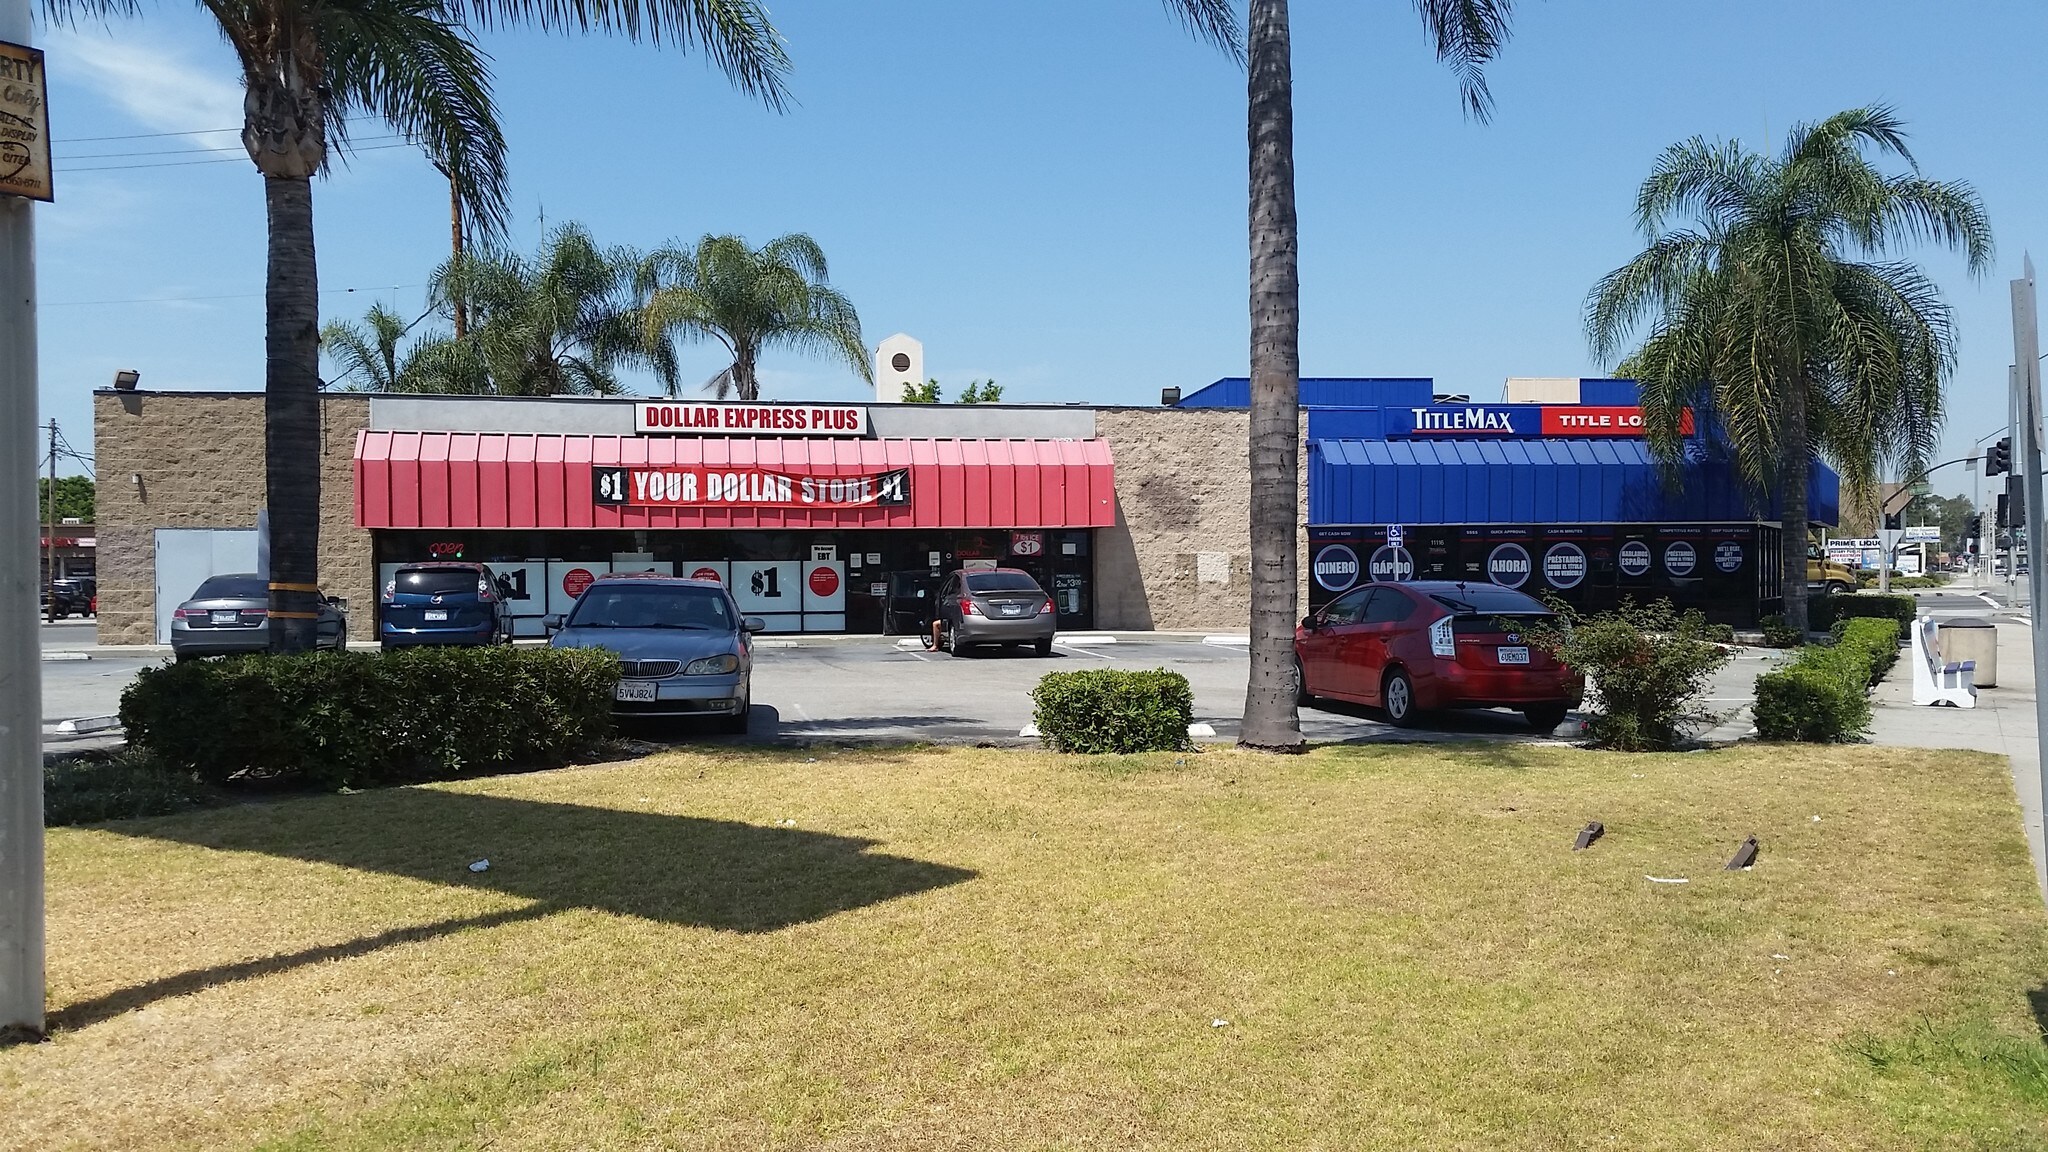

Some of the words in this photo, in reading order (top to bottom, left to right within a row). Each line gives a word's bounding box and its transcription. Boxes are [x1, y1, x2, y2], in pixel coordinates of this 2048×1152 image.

[1, 128, 38, 142] DISPLAY
[646, 407, 718, 428] DOLLAR
[724, 408, 807, 429] EXPRESS
[812, 410, 858, 430] PLUS
[1560, 415, 1611, 426] TITLE
[600, 472, 622, 500] $1
[634, 472, 698, 501] YOUR
[708, 473, 792, 502] DOLLAR
[801, 477, 872, 503] STORE
[883, 474, 903, 500] $1
[1020, 541, 1033, 553] $1
[1548, 555, 1582, 563] PRÉSTAMOS
[1622, 557, 1648, 566] ESPAÑOL
[1318, 562, 1356, 574] DINERO
[1491, 560, 1527, 572] AHORA
[751, 567, 782, 597] $1
[620, 689, 652, 699] 5VWJ824
